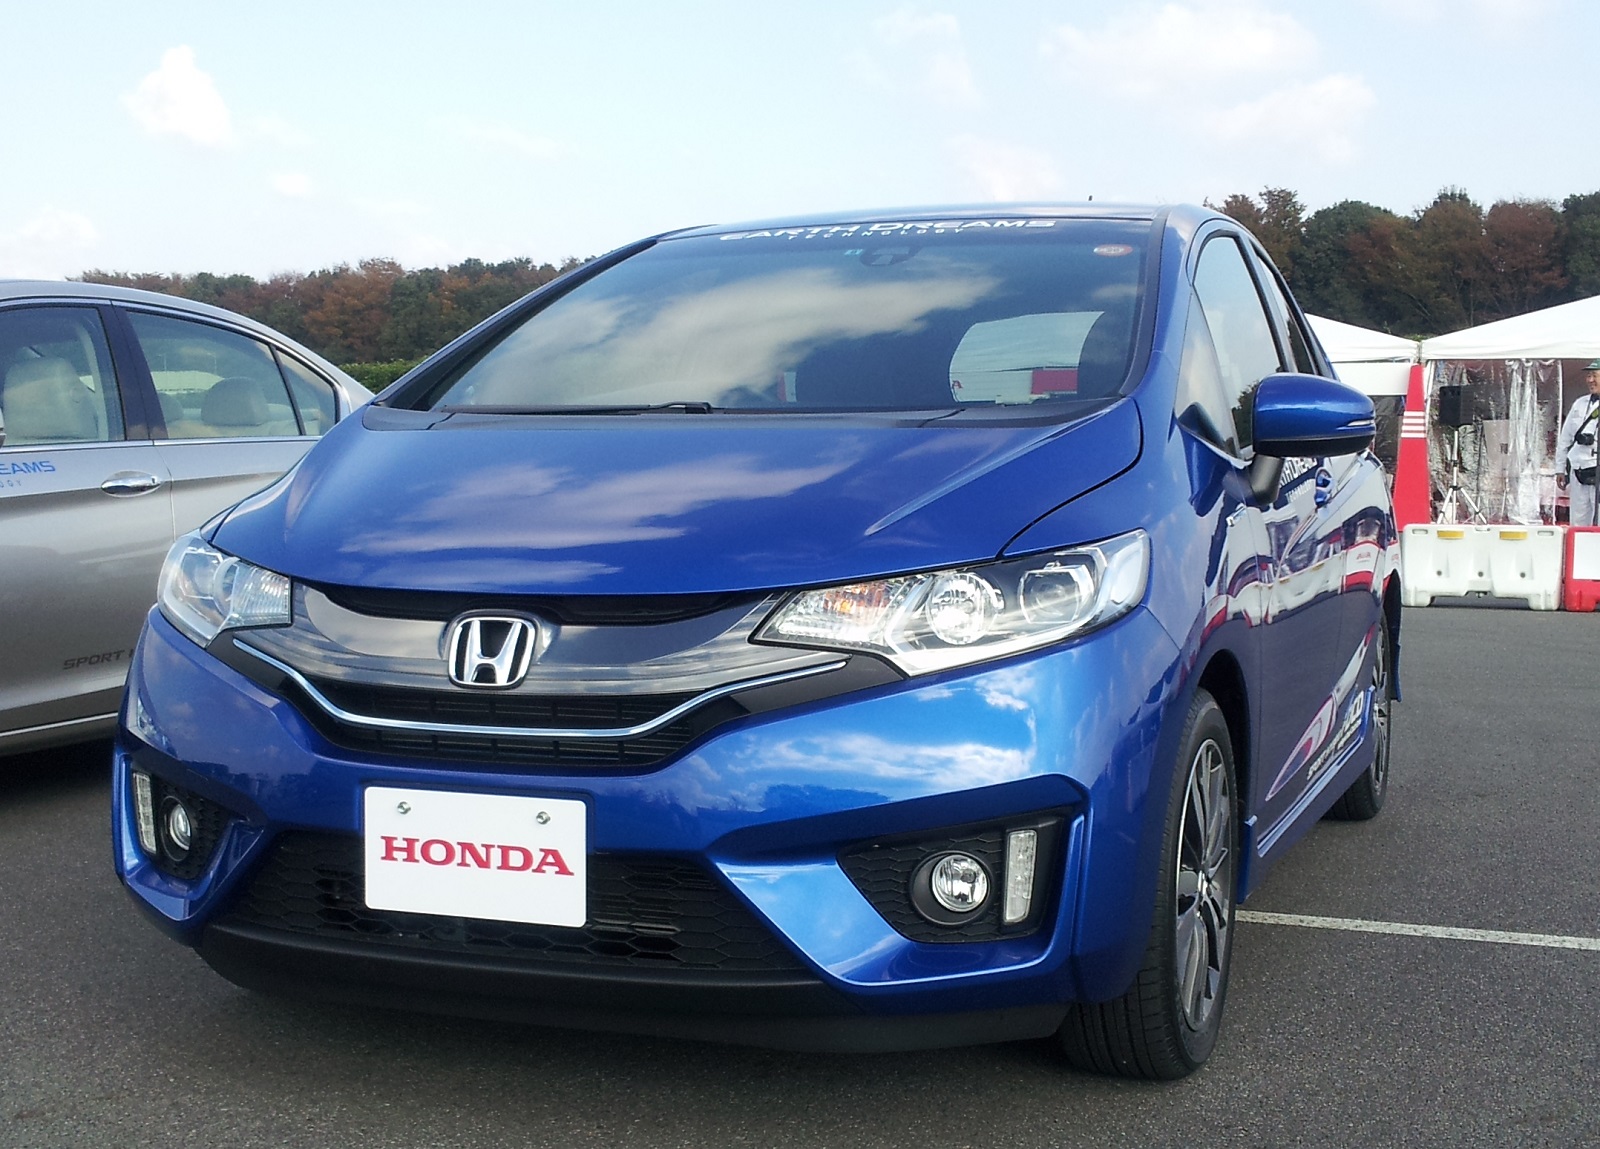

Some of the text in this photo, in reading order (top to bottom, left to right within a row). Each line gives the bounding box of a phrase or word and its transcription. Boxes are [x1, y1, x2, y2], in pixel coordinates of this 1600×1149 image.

[719, 219, 1057, 241] EARTH DREAMS
[62, 649, 125, 670] SPORT
[380, 835, 575, 877] HONDA
